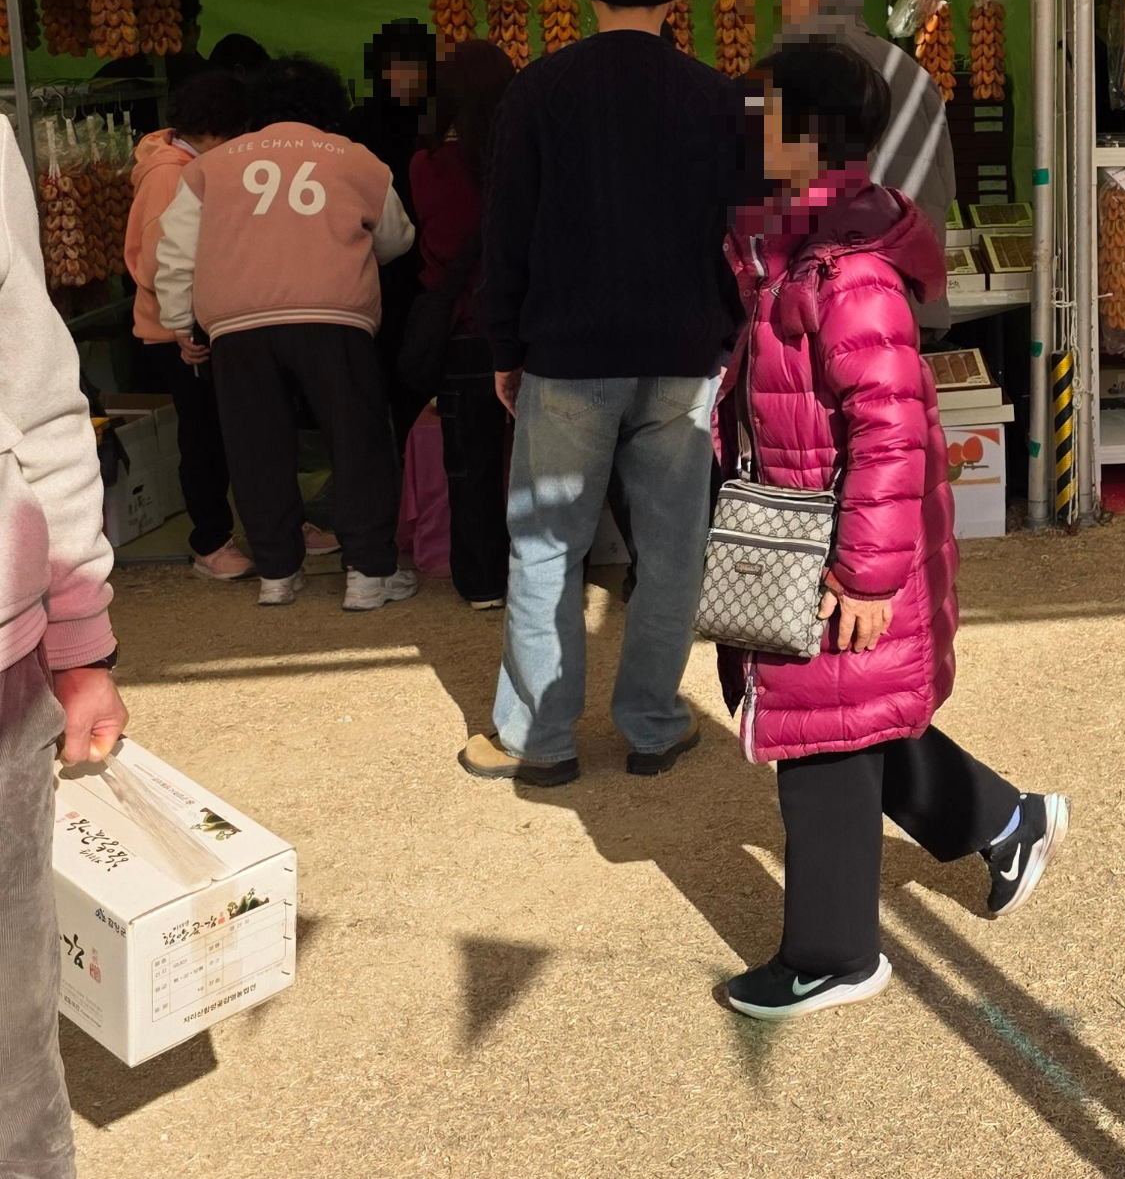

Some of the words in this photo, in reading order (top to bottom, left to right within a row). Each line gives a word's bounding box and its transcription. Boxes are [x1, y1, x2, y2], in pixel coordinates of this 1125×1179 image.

[228, 141, 254, 154] LEE
[261, 139, 304, 149] CHAN
[311, 140, 345, 154] WON
[242, 160, 326, 215] 96
